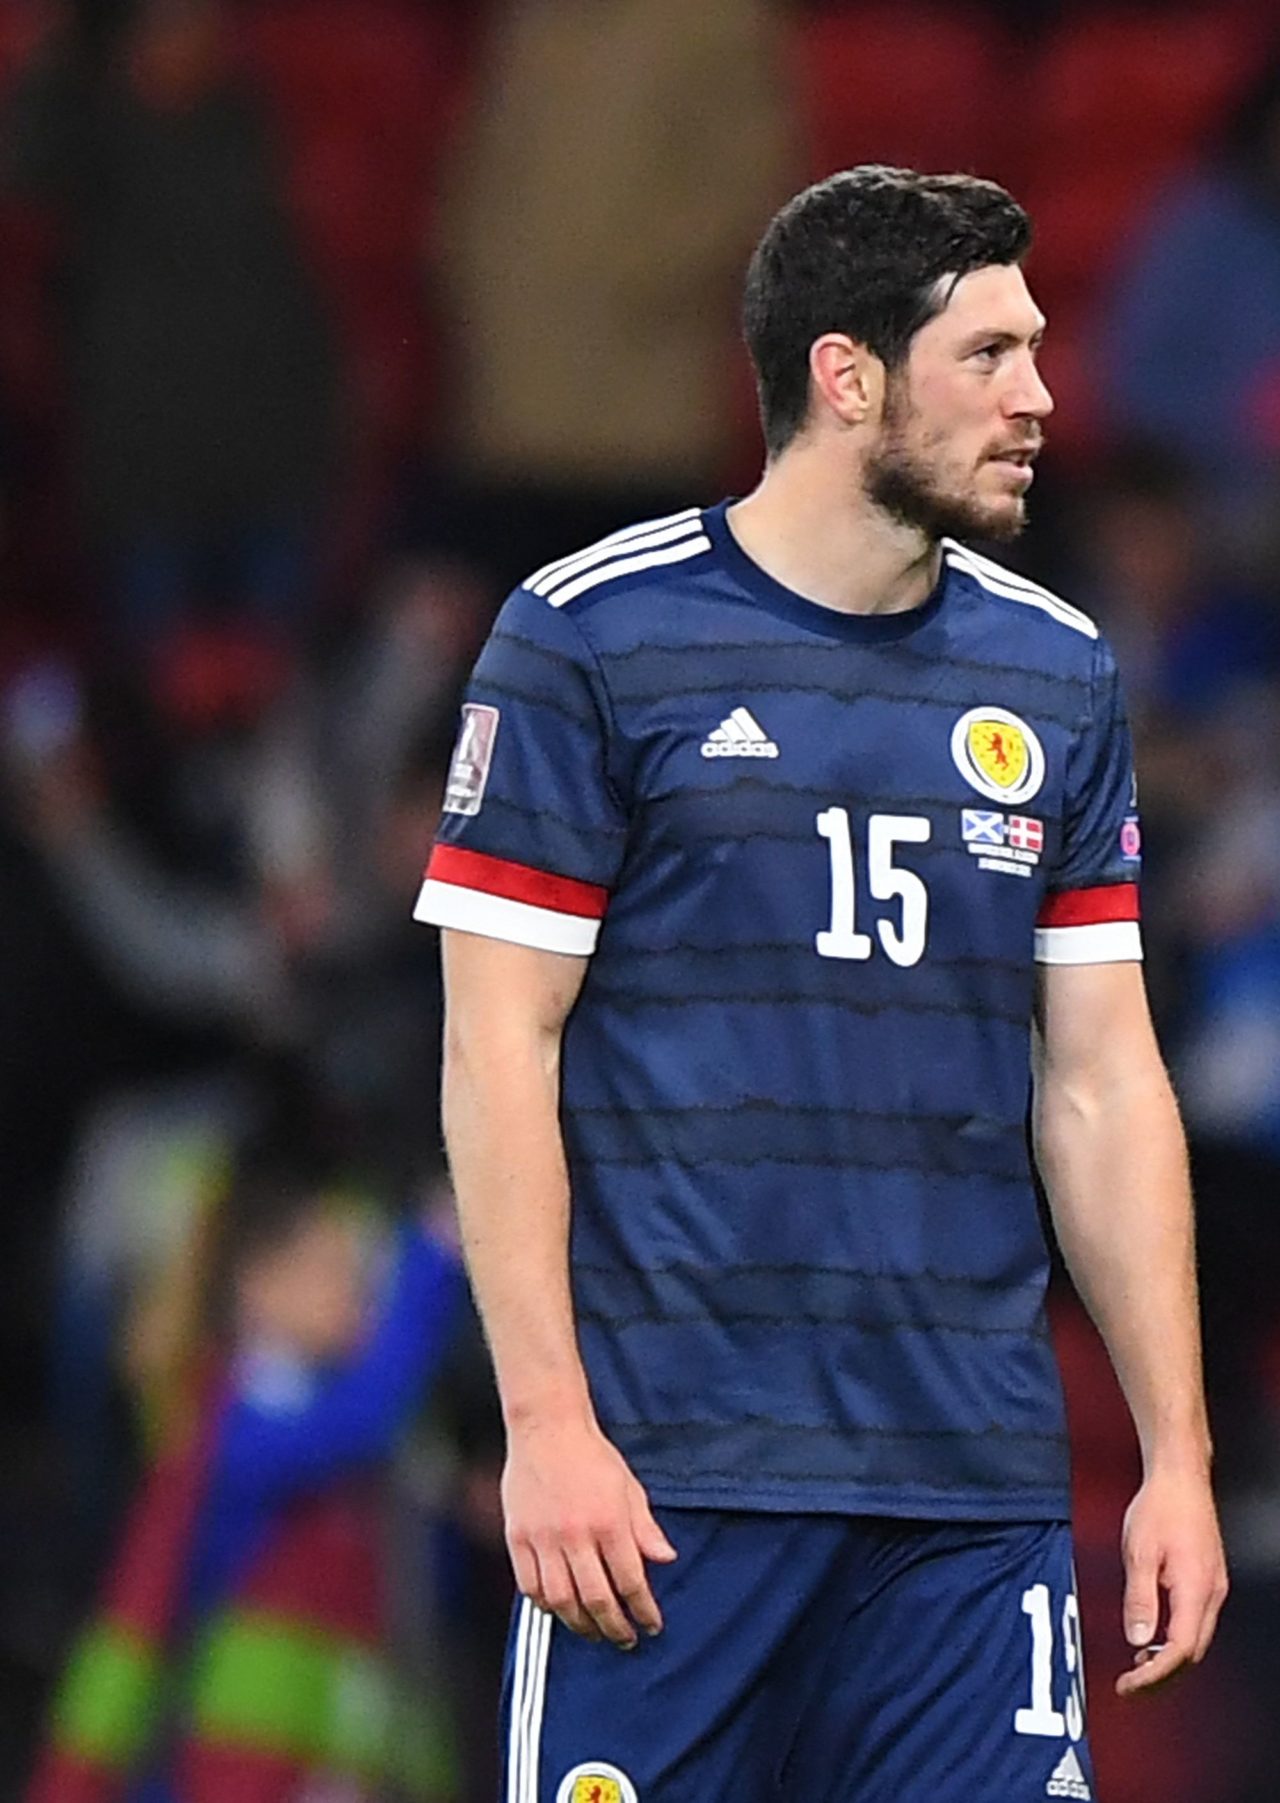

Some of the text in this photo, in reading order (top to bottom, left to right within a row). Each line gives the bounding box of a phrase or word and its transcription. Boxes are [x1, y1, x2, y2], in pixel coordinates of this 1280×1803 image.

[701, 740, 779, 758] adidas
[816, 807, 931, 967] 15
[1046, 1779, 1091, 1801] adidas
